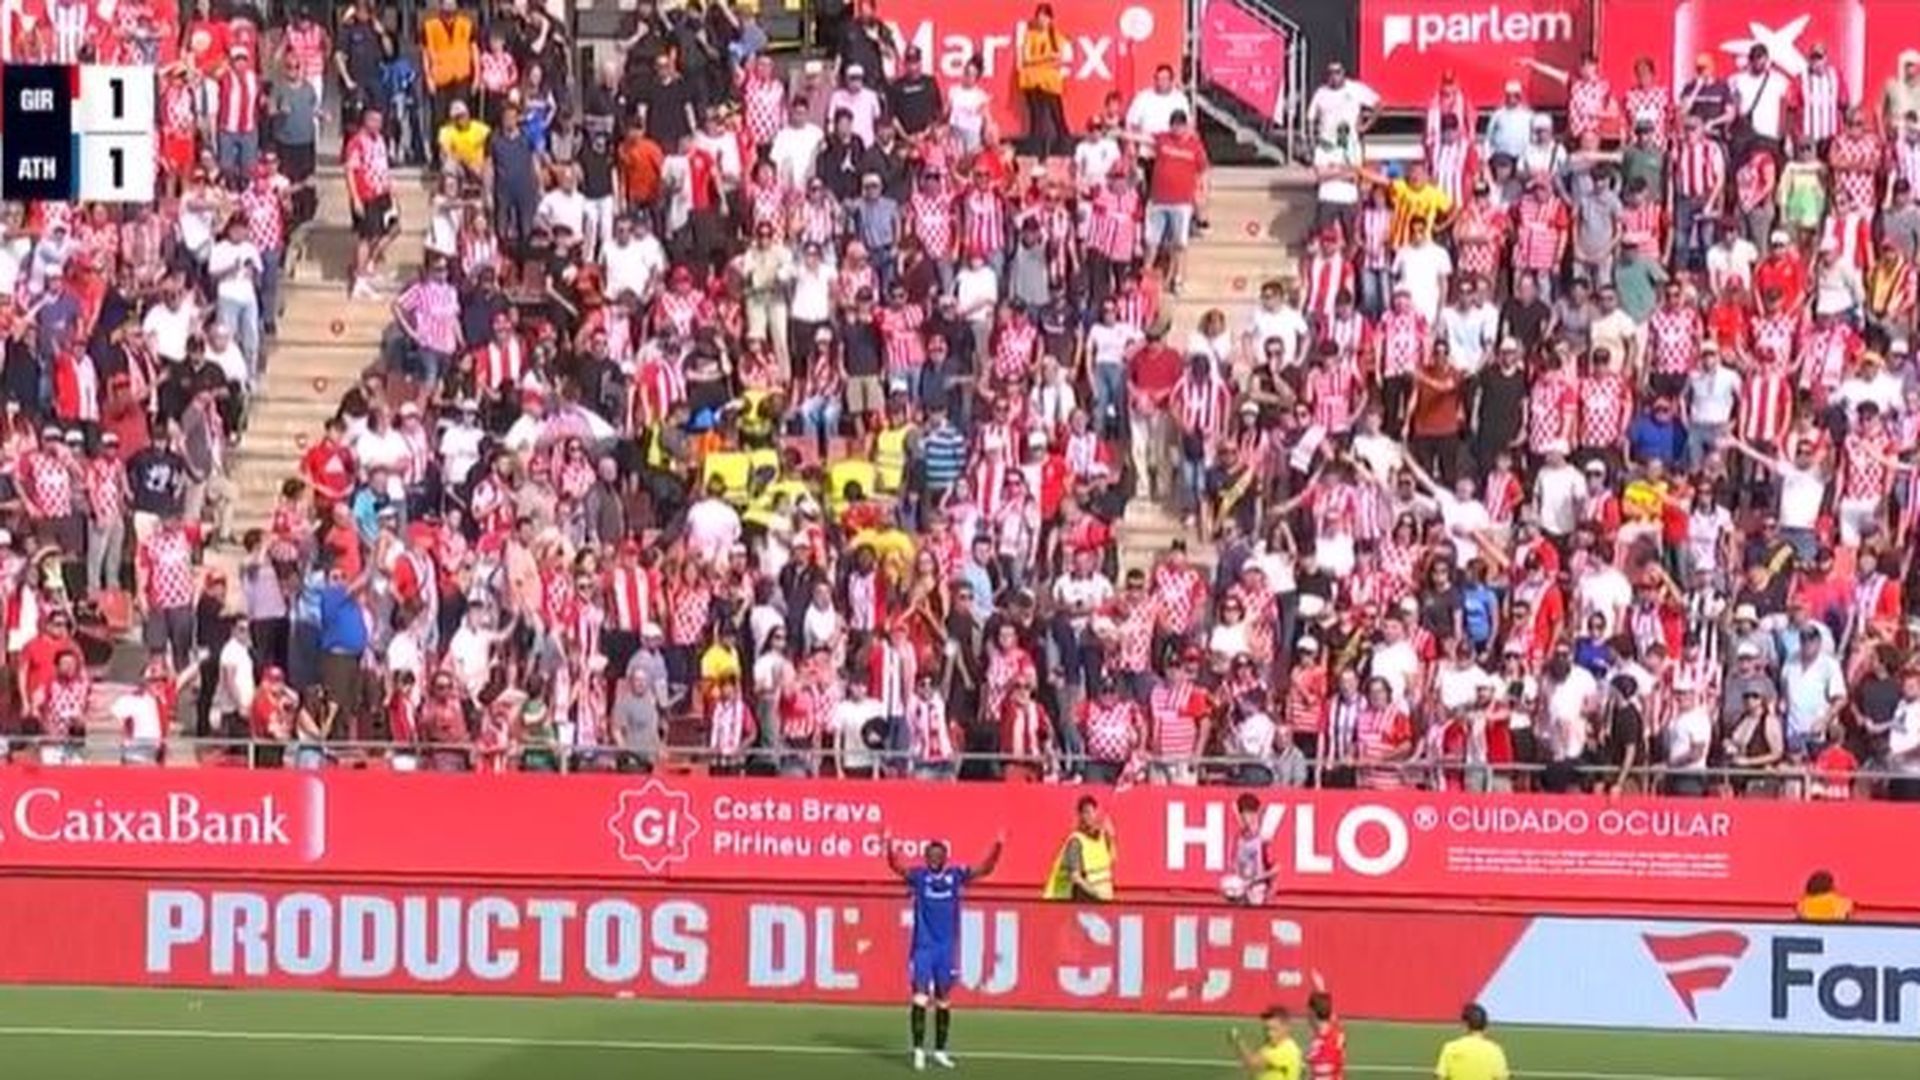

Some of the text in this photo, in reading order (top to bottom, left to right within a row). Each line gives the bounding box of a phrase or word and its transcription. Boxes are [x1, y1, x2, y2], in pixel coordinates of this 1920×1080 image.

[1417, 5, 1572, 53] parlem
[14, 787, 291, 844] CaixaBank
[713, 796, 881, 823] Costa Brava
[1449, 806, 1731, 837] CUIDADO OCULAR
[713, 831, 811, 857] Pirineu
[821, 834, 851, 857] de
[146, 888, 709, 987] PRODUCTOS
[901, 908, 1019, 995] U
[1771, 934, 1920, 1024] Fan
